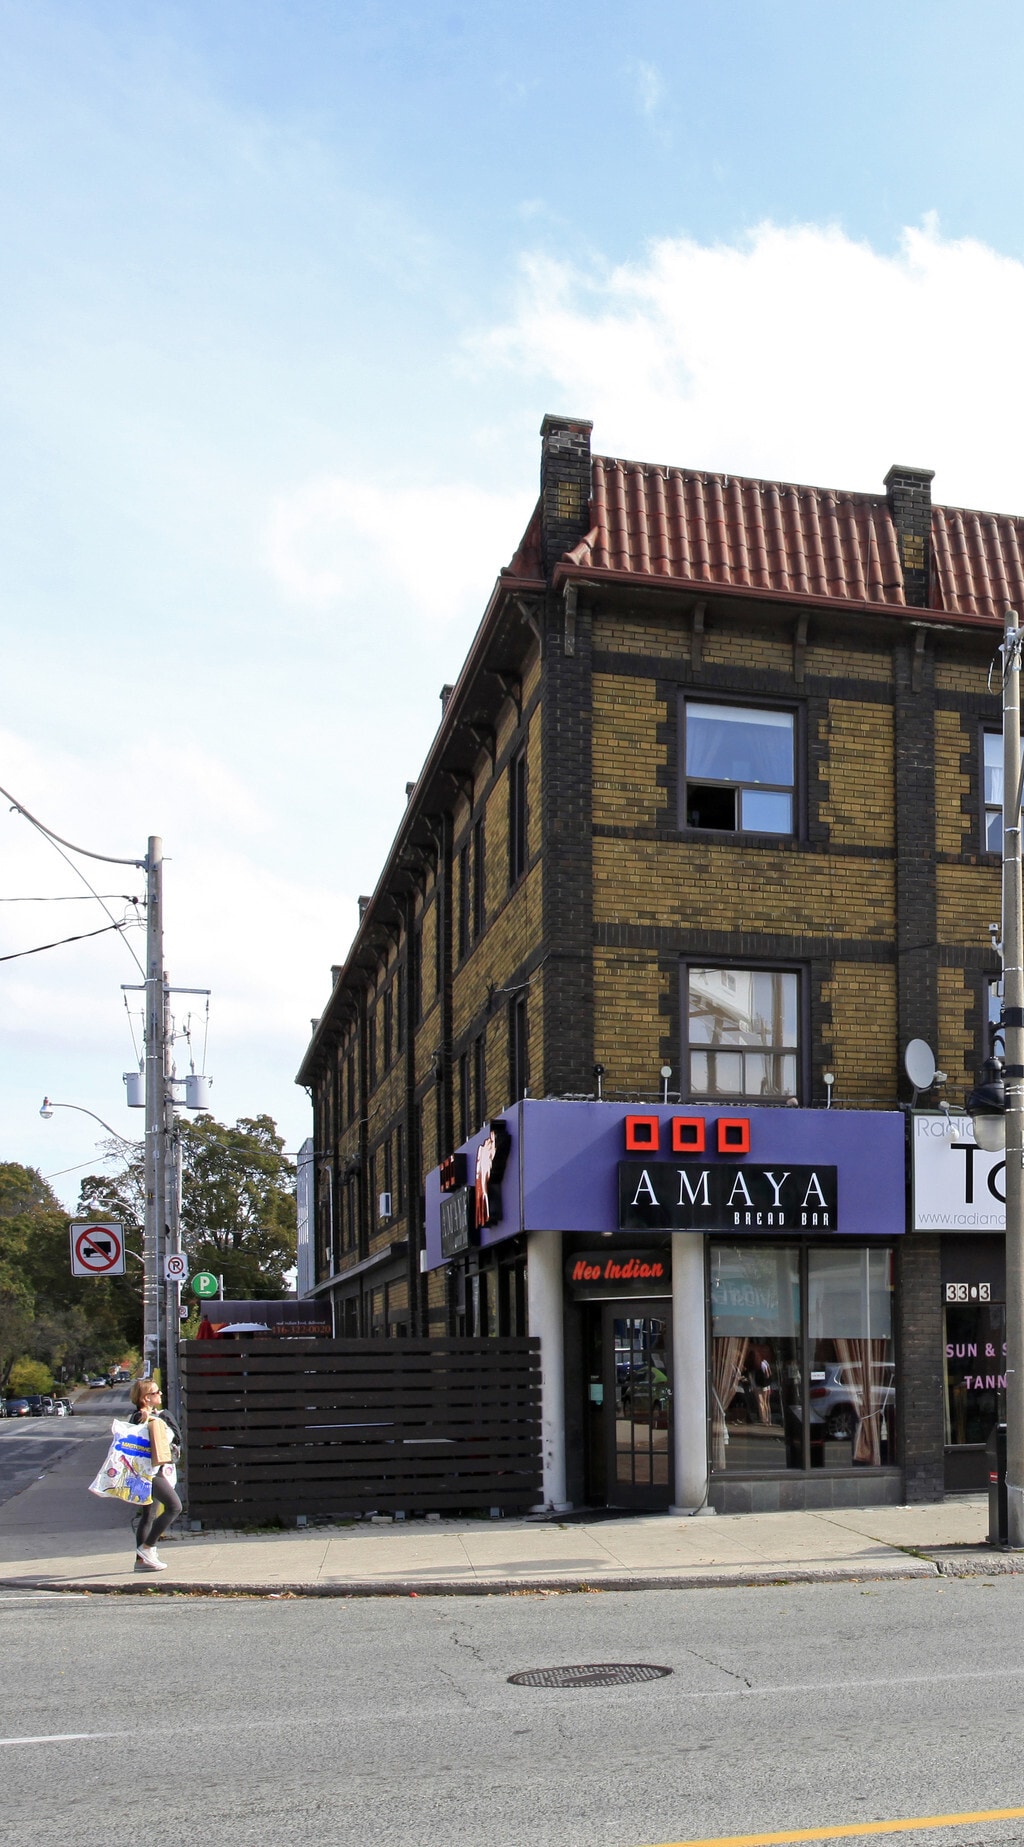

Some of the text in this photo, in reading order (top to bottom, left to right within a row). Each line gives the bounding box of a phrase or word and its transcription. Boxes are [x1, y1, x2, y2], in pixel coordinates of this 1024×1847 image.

[630, 1169, 829, 1207] AMAYA
[734, 1211, 829, 1226] BREAD BAR
[572, 1258, 664, 1280] Neo Indian
[200, 1276, 210, 1291] P
[945, 1343, 978, 1358] SUN
[985, 1342, 996, 1357] &
